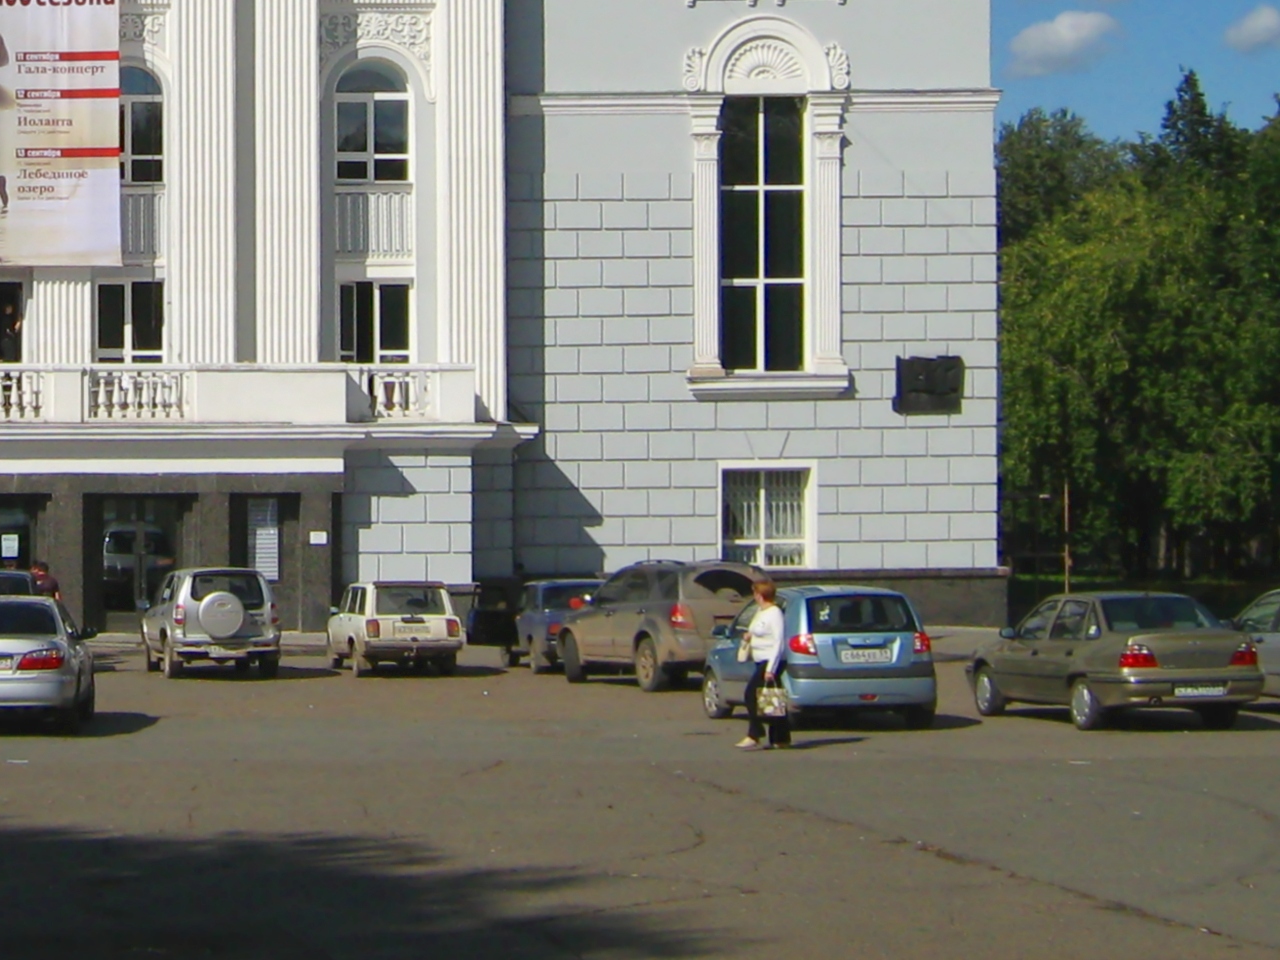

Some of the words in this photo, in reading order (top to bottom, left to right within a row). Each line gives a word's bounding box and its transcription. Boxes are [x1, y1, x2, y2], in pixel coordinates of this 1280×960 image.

[17, 64, 106, 76] Гала-концерт
[17, 116, 74, 127] Иоланта
[16, 168, 89, 181] Лебединое
[17, 185, 56, 196] озеро
